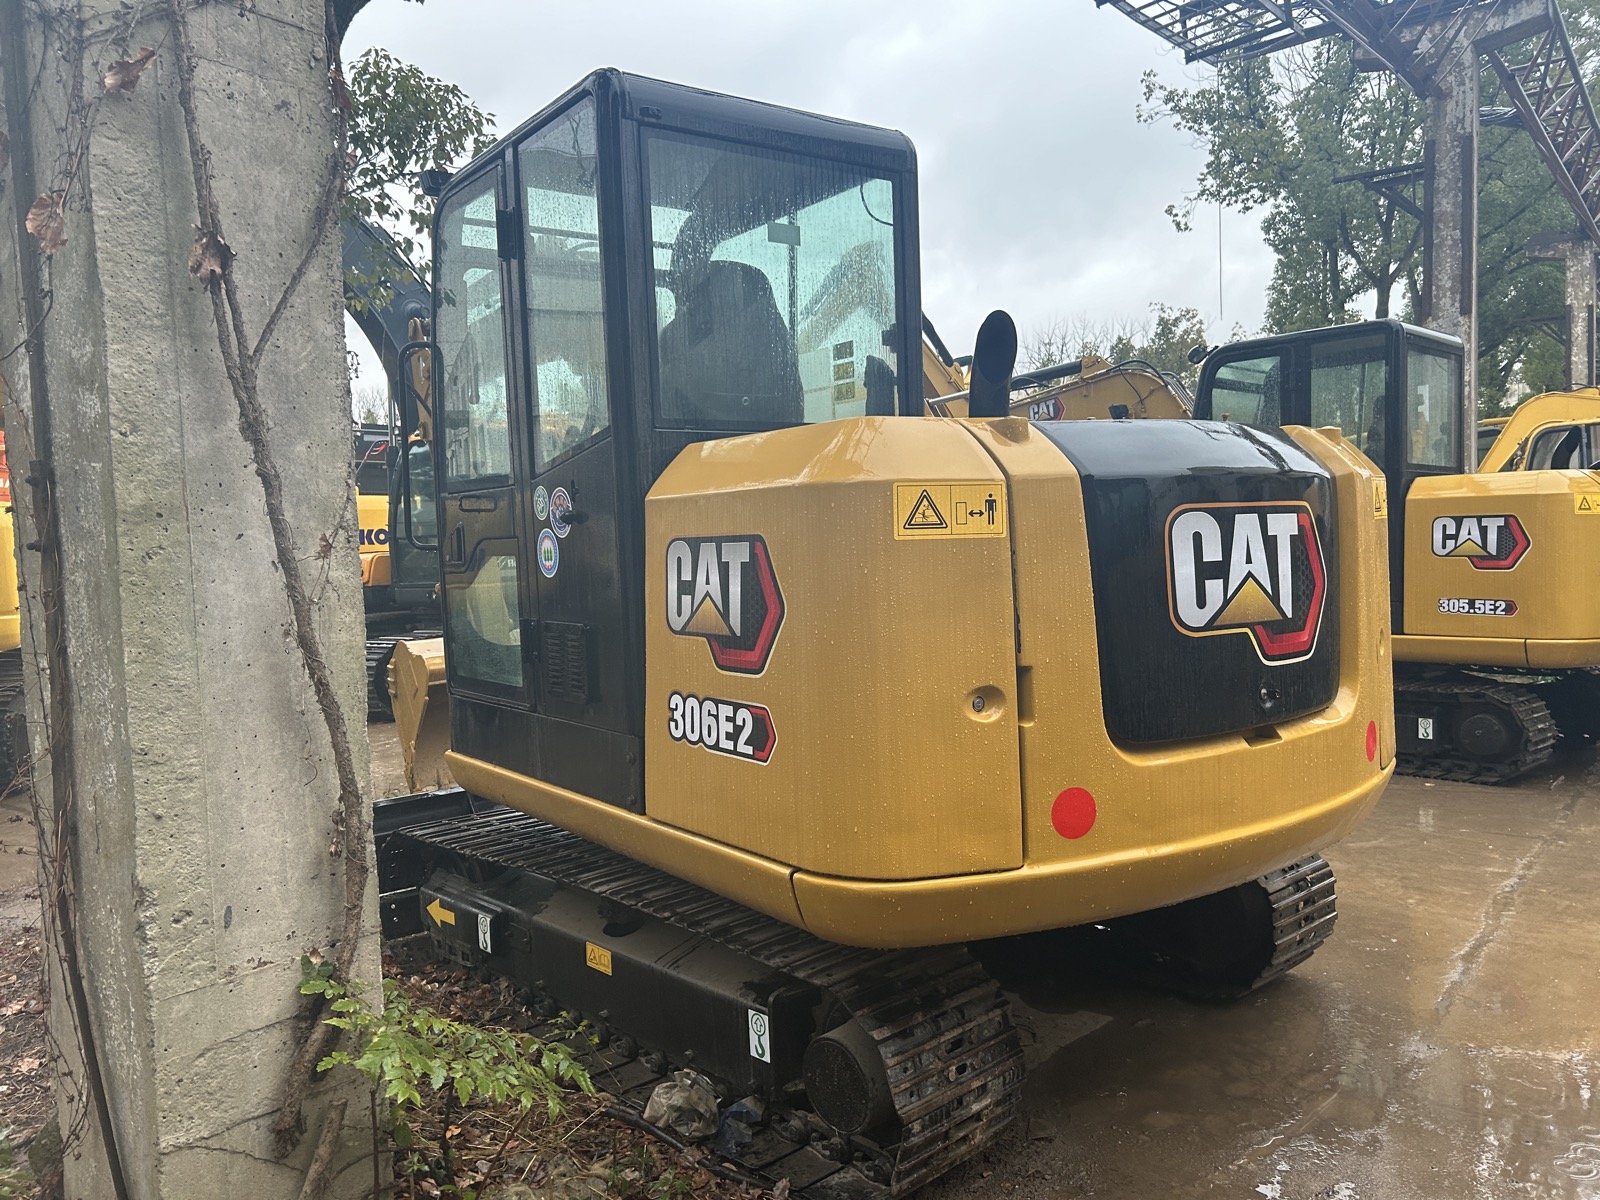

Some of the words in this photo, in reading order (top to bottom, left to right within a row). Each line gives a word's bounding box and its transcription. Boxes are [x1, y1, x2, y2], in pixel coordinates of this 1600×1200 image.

[1029, 399, 1056, 421] CAT
[1432, 517, 1505, 556] CAT
[667, 540, 750, 637] CAT
[1171, 511, 1299, 628] CAT
[1439, 599, 1506, 615] 305.5E2
[669, 693, 754, 756] 306E2
